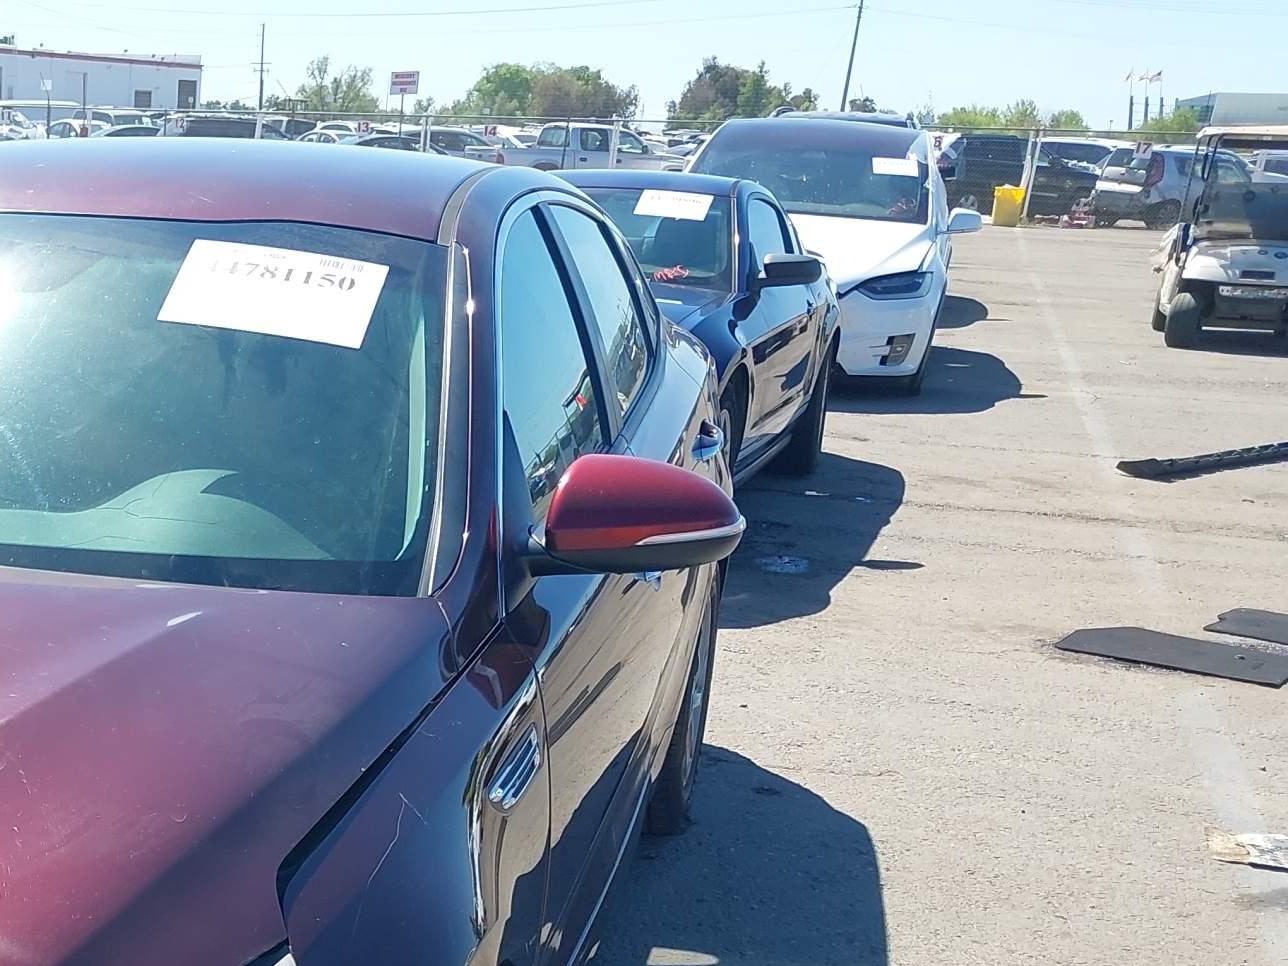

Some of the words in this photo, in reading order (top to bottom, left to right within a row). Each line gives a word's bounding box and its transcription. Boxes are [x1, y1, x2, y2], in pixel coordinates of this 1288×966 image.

[358, 121, 369, 132] 13
[484, 125, 497, 137] 14
[1136, 142, 1152, 154] 17
